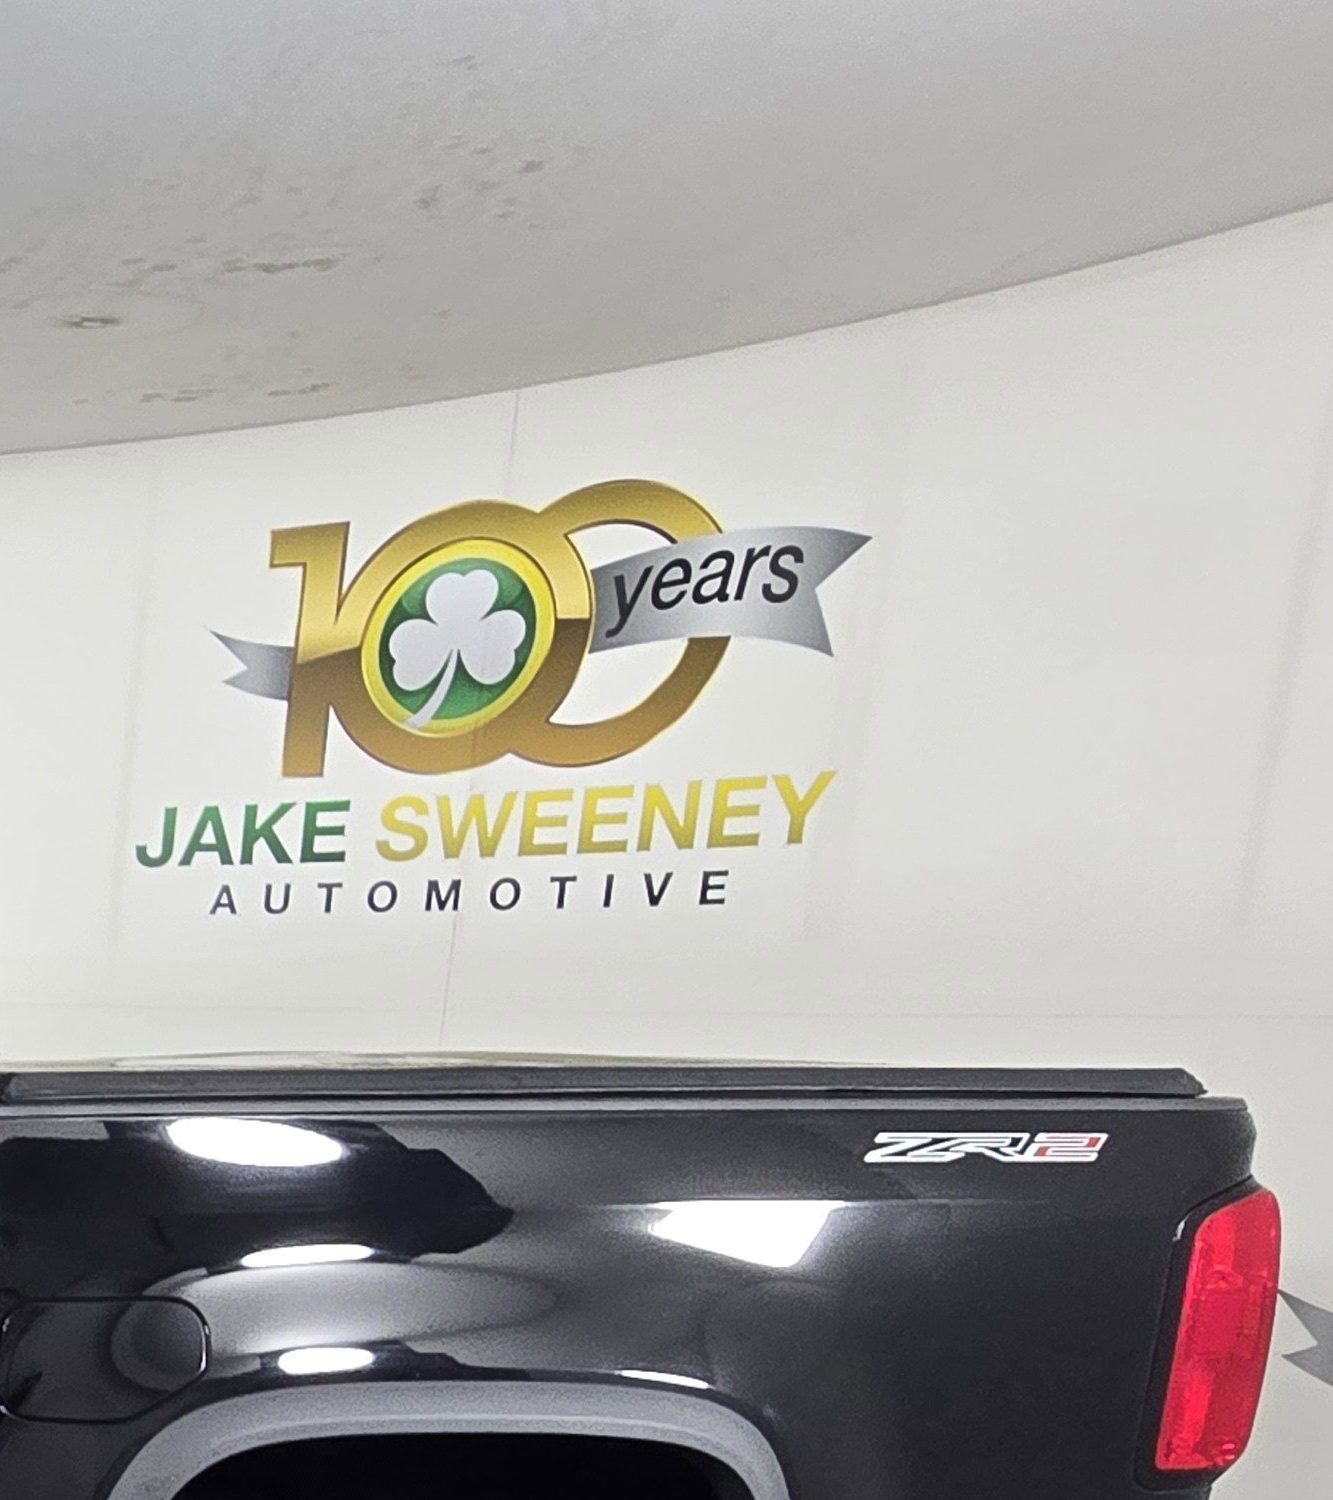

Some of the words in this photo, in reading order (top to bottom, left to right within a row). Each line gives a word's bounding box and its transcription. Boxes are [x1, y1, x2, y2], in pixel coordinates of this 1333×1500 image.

[604, 541, 807, 639] years
[136, 799, 351, 868] JAKE
[376, 770, 839, 862] SWEENEY
[210, 869, 730, 916] AUTOMOTIVE
[864, 1132, 1109, 1163] ZR2
